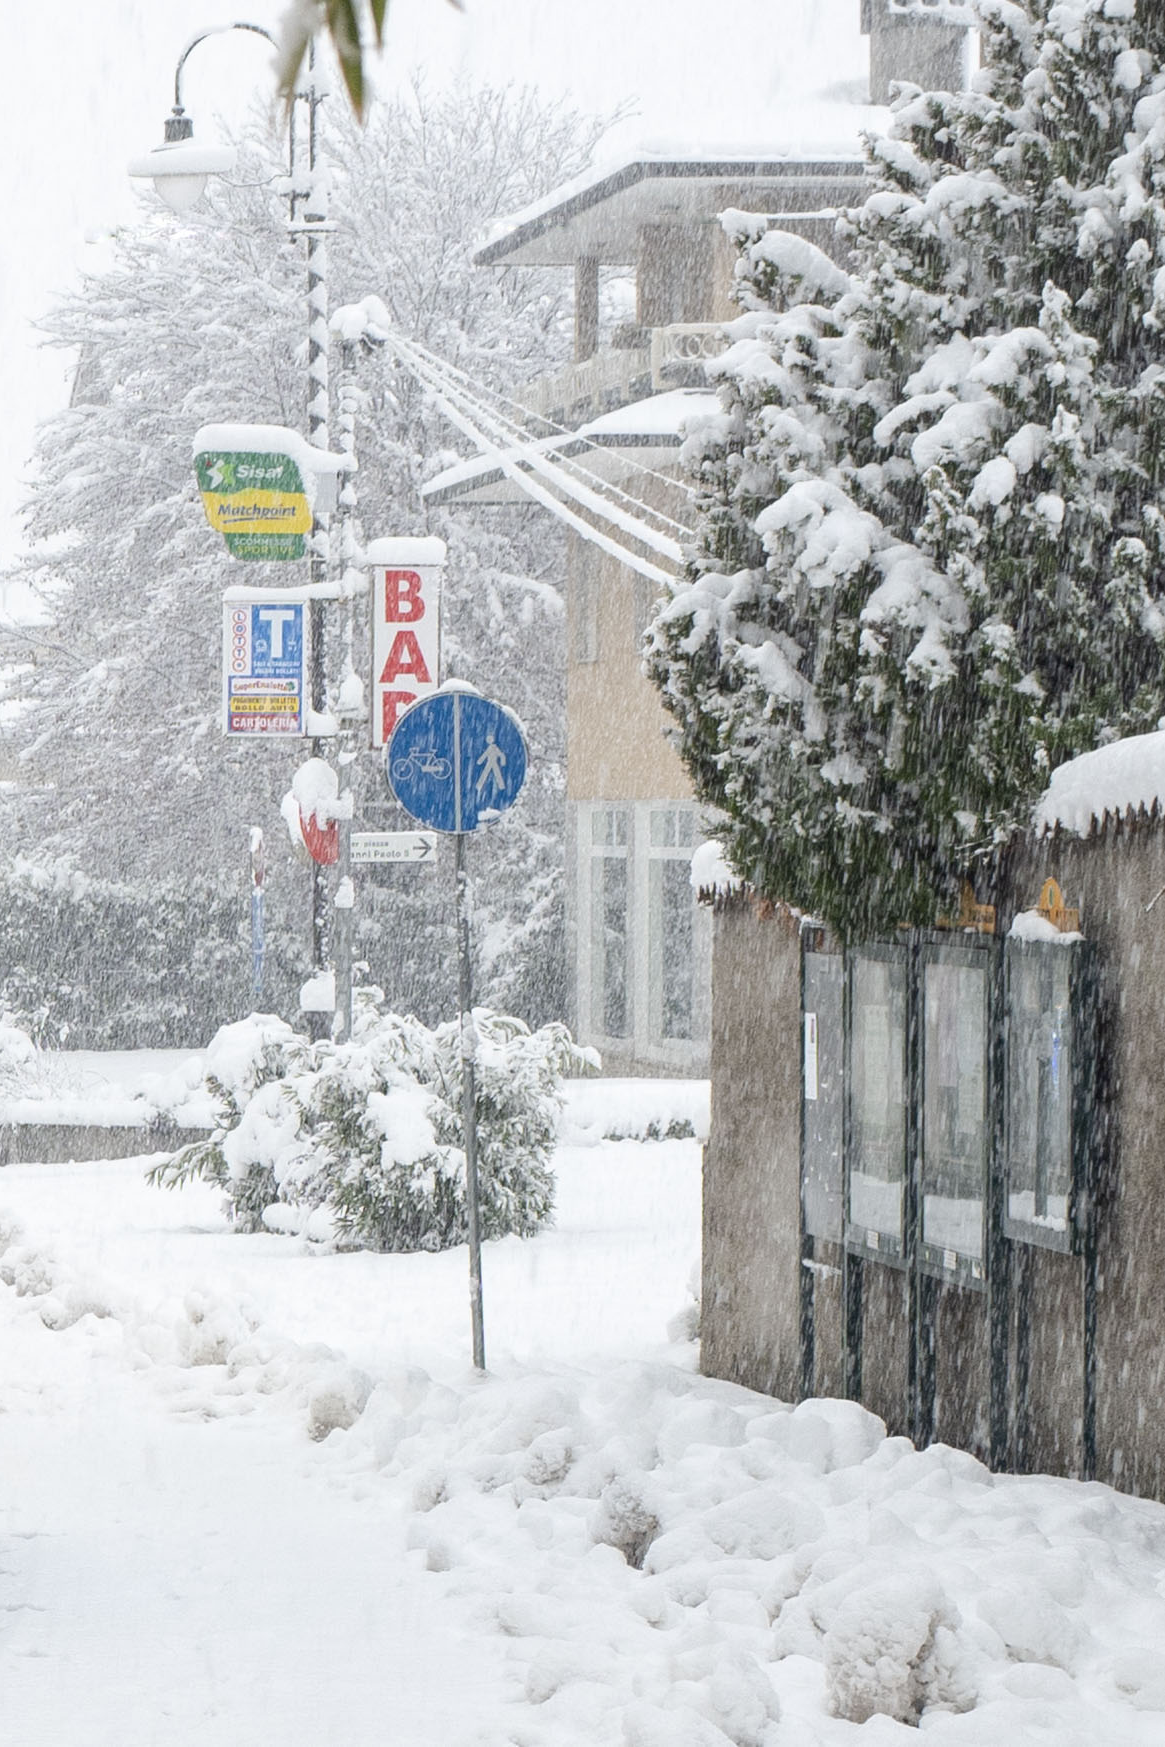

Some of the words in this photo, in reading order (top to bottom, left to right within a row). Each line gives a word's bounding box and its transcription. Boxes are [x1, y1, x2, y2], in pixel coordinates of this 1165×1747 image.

[236, 464, 284, 479] Sisal
[217, 503, 297, 520] Matchpoint
[259, 609, 295, 658] T
[232, 716, 298, 728] CARTOLERIA
[373, 849, 402, 858] Paolo
